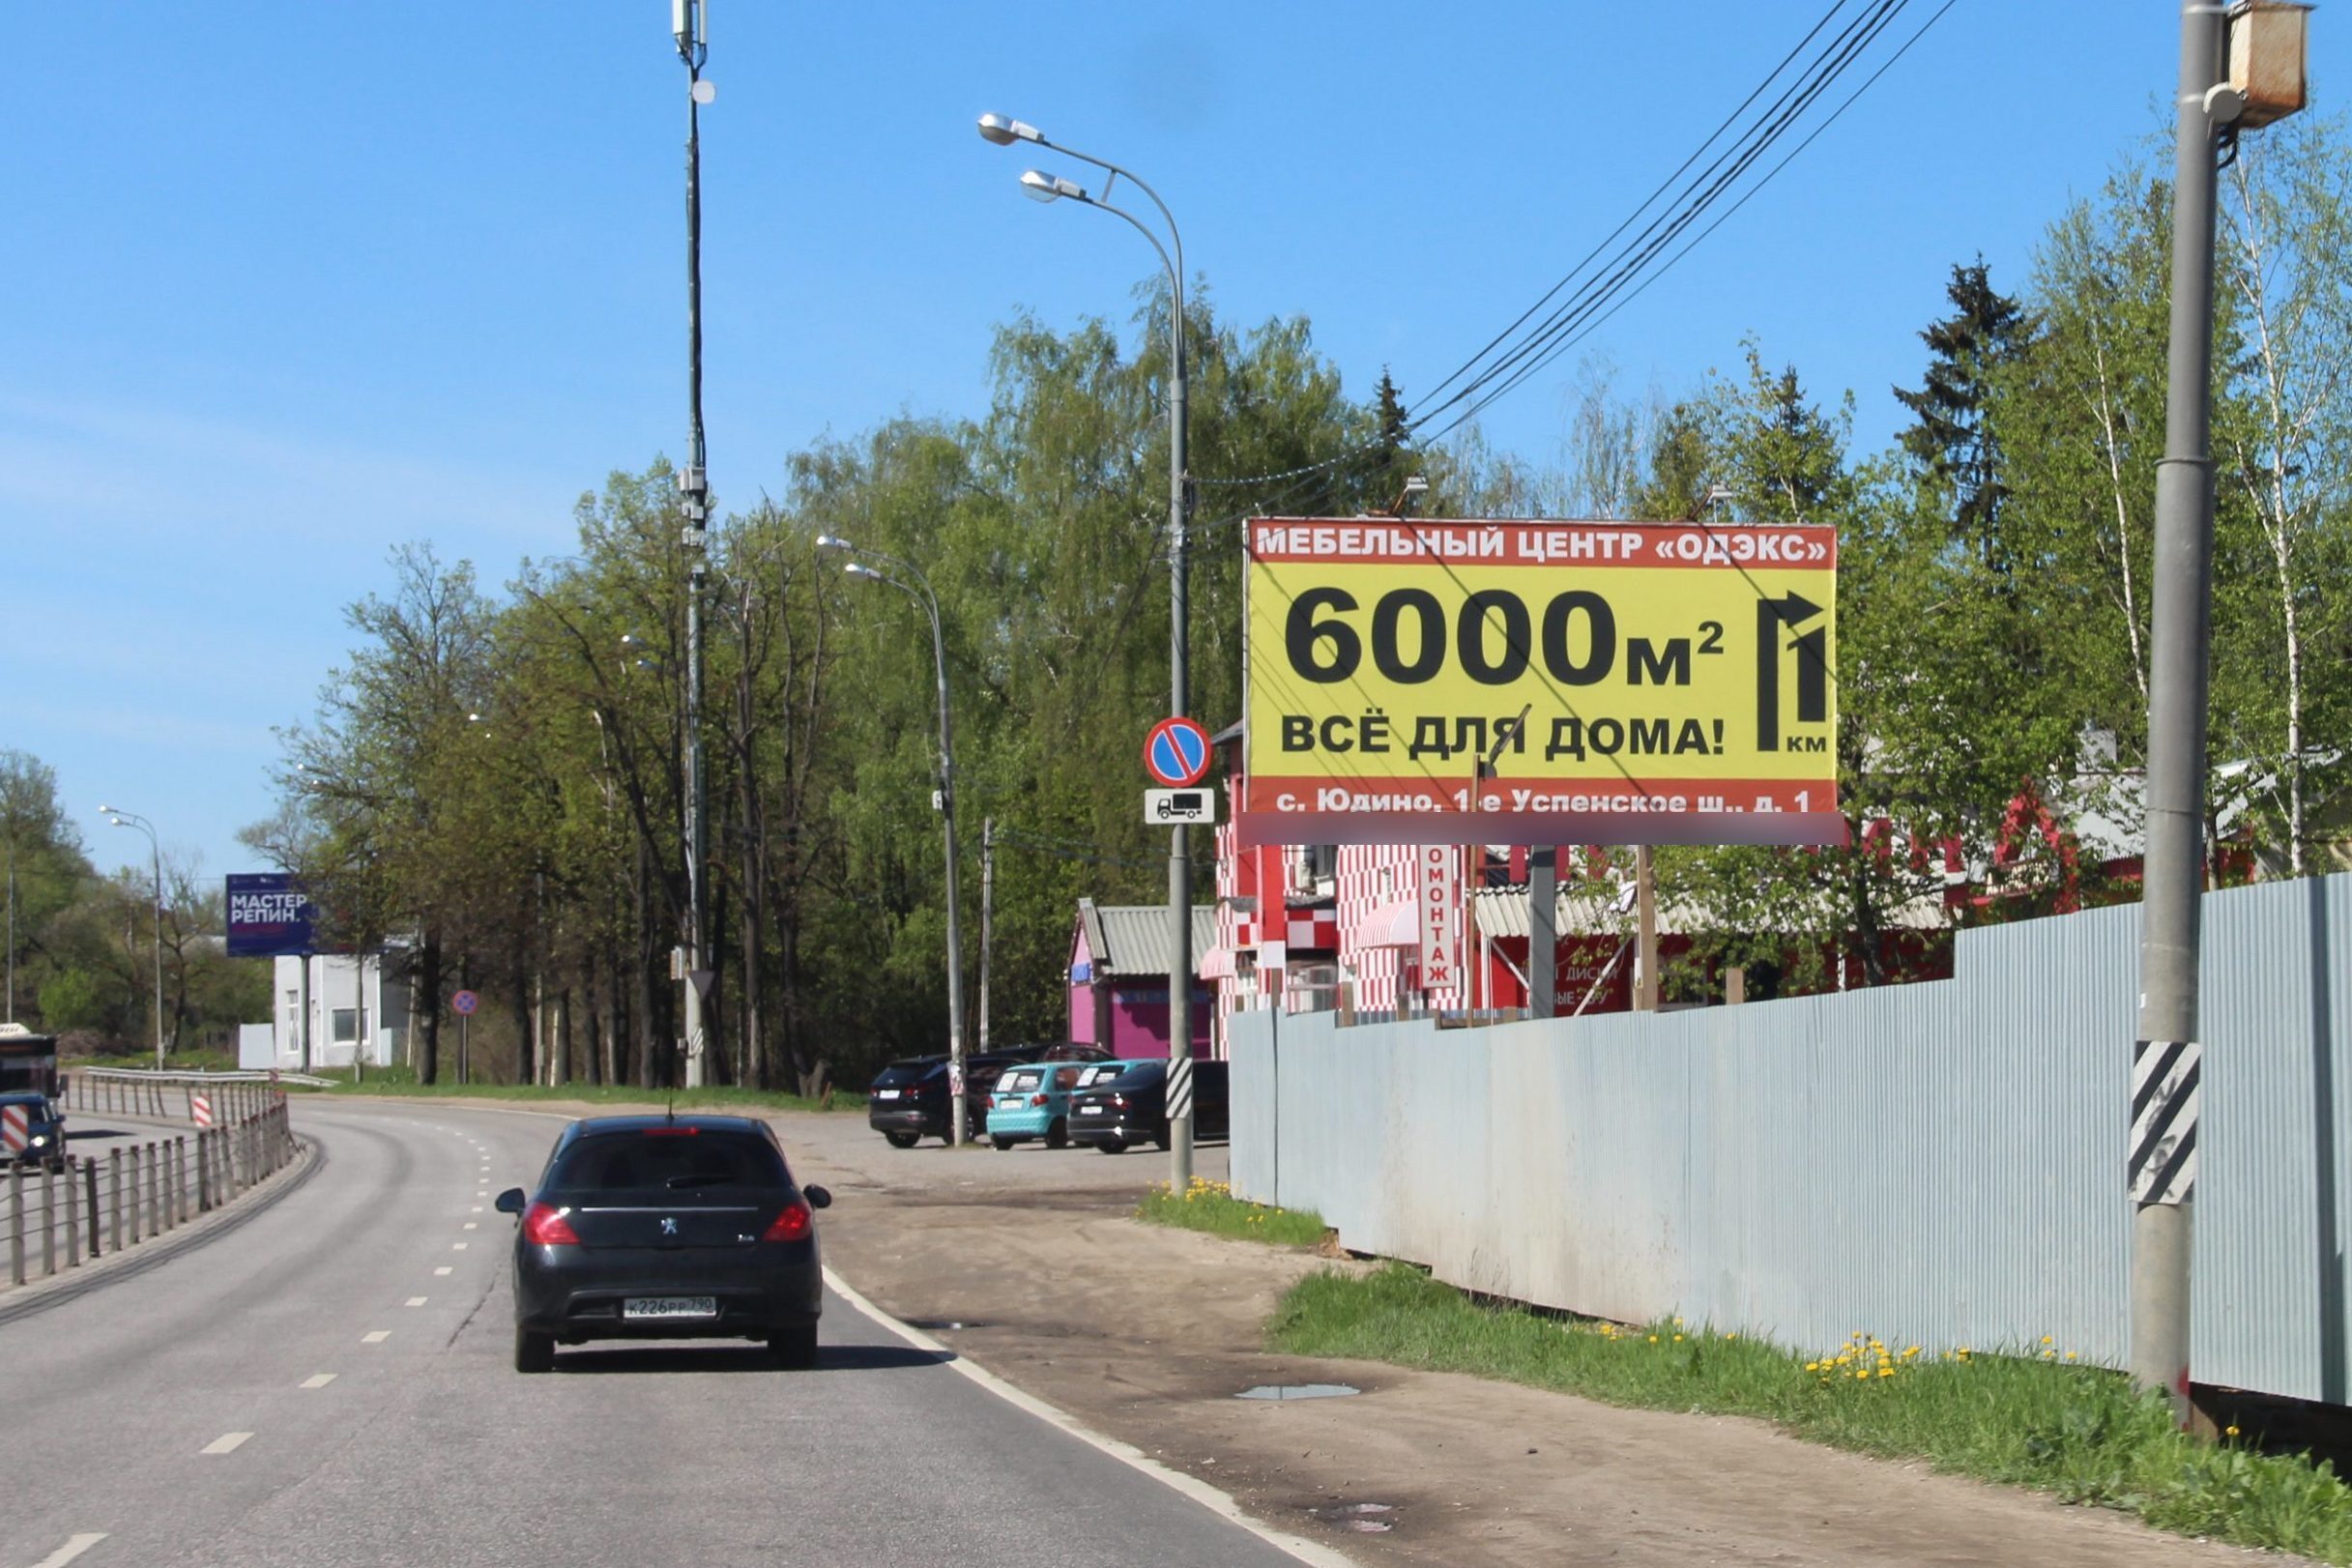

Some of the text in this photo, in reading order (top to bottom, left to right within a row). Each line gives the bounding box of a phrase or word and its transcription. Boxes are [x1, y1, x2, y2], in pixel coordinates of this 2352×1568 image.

[1257, 526, 1827, 565] МЕБЕЛЬНЫЙ ЦЕНТР «ОДЭКС»
[1786, 624, 1826, 722] 1
[1282, 708, 1725, 762] ВСЁ ДЛЯ ДОМА!
[1276, 794, 1306, 812] с.
[1511, 789, 1687, 812] Успенское
[1794, 791, 1809, 812] 1
[231, 894, 307, 909] МАСТЕР
[231, 909, 301, 923] РЕПИН.
